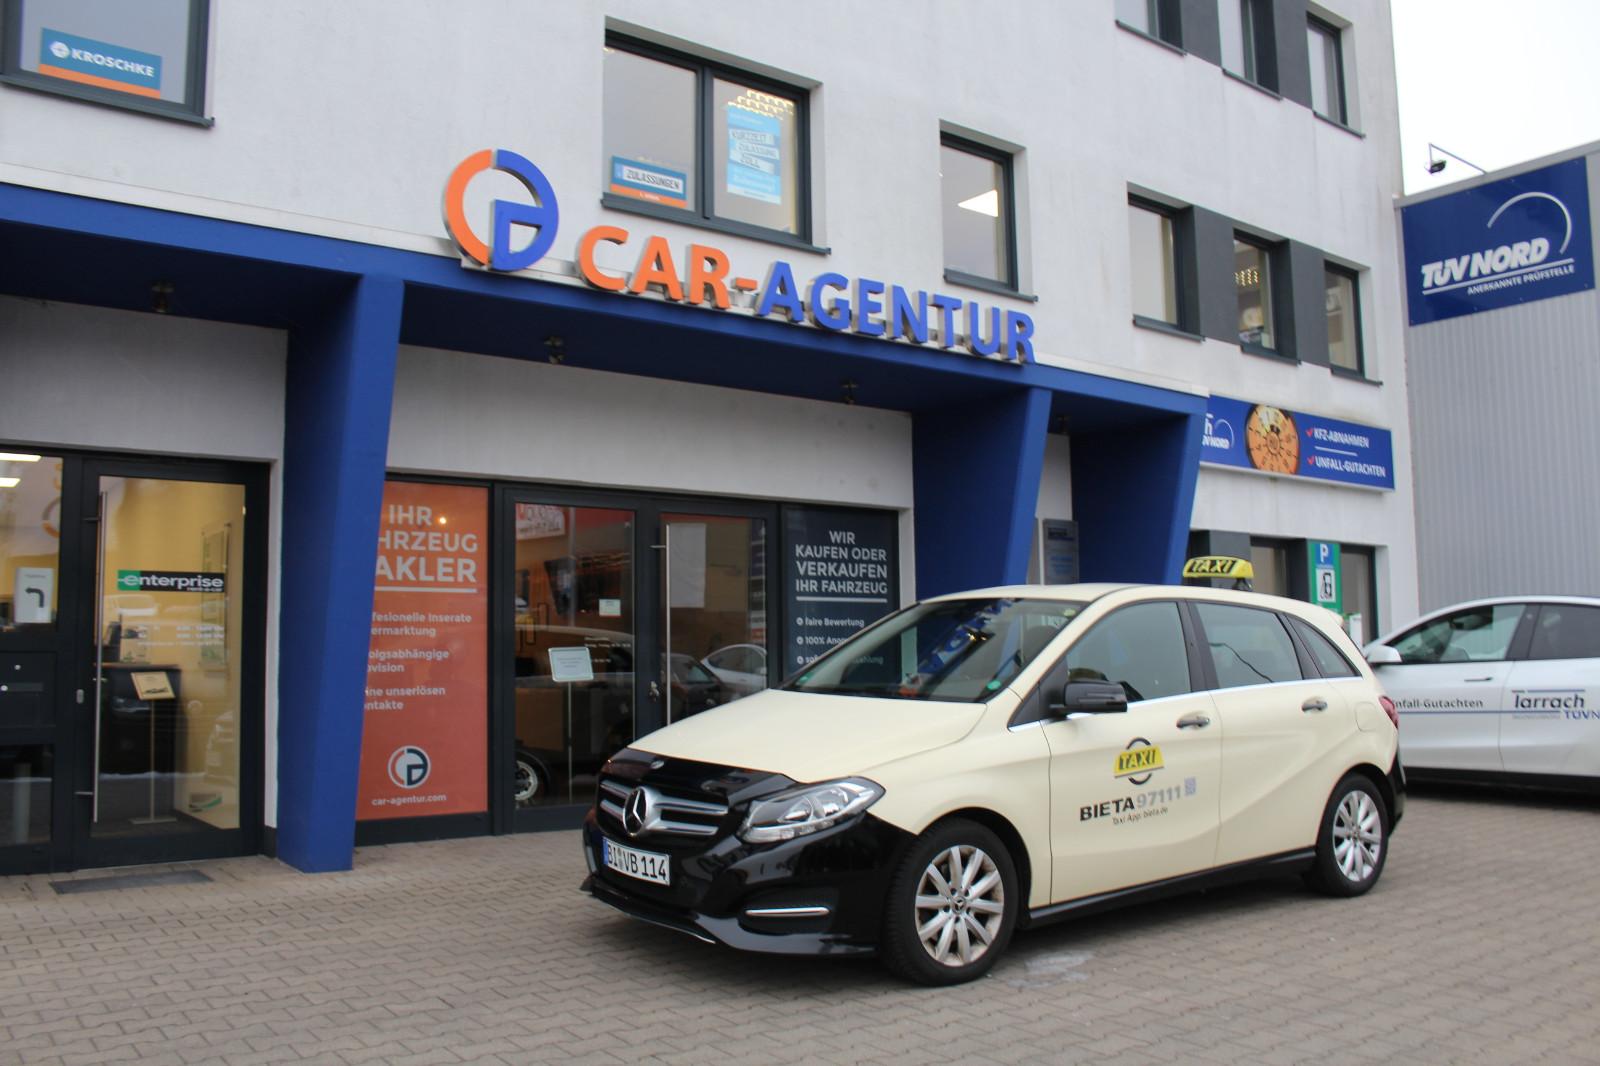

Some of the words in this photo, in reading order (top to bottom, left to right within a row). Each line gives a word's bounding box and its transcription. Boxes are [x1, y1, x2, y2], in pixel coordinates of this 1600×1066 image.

[71, 48, 155, 77] KROSCHKE
[1469, 237, 1549, 278] NORD
[1467, 274, 1522, 296] ANERKANNTE
[1523, 264, 1575, 285] PRÜFSTELLE
[576, 225, 1036, 363] CAR-AGENTUR
[1313, 427, 1370, 449] KFZ-ABNAHMEN
[1314, 455, 1386, 478] UNFALL-GUTACHTEN
[389, 504, 433, 526] IHR
[379, 529, 479, 554] HRZEUG
[829, 530, 856, 545] WIR
[796, 543, 849, 560] KAUFEN
[851, 547, 887, 561] ODER
[1319, 543, 1329, 562] P
[376, 554, 478, 583] AKLER
[796, 560, 888, 579] VERKAUFEN
[1188, 559, 1236, 574] TAXI
[119, 574, 225, 590] enterprise
[796, 579, 818, 593] IHR
[821, 580, 888, 595] FAHRZEUG
[428, 613, 472, 623] Inserate
[804, 616, 823, 627] faire
[824, 617, 865, 629] Bewertung
[804, 635, 825, 645] 100%
[364, 700, 405, 711] ntakte
[1119, 749, 1157, 770] TAXI
[371, 793, 448, 806] car-agentur.com
[1080, 796, 1136, 821] BIETA
[1136, 785, 1182, 809] 97111
[608, 844, 618, 867] BI
[623, 850, 639, 874] VB
[641, 855, 667, 881] 114
